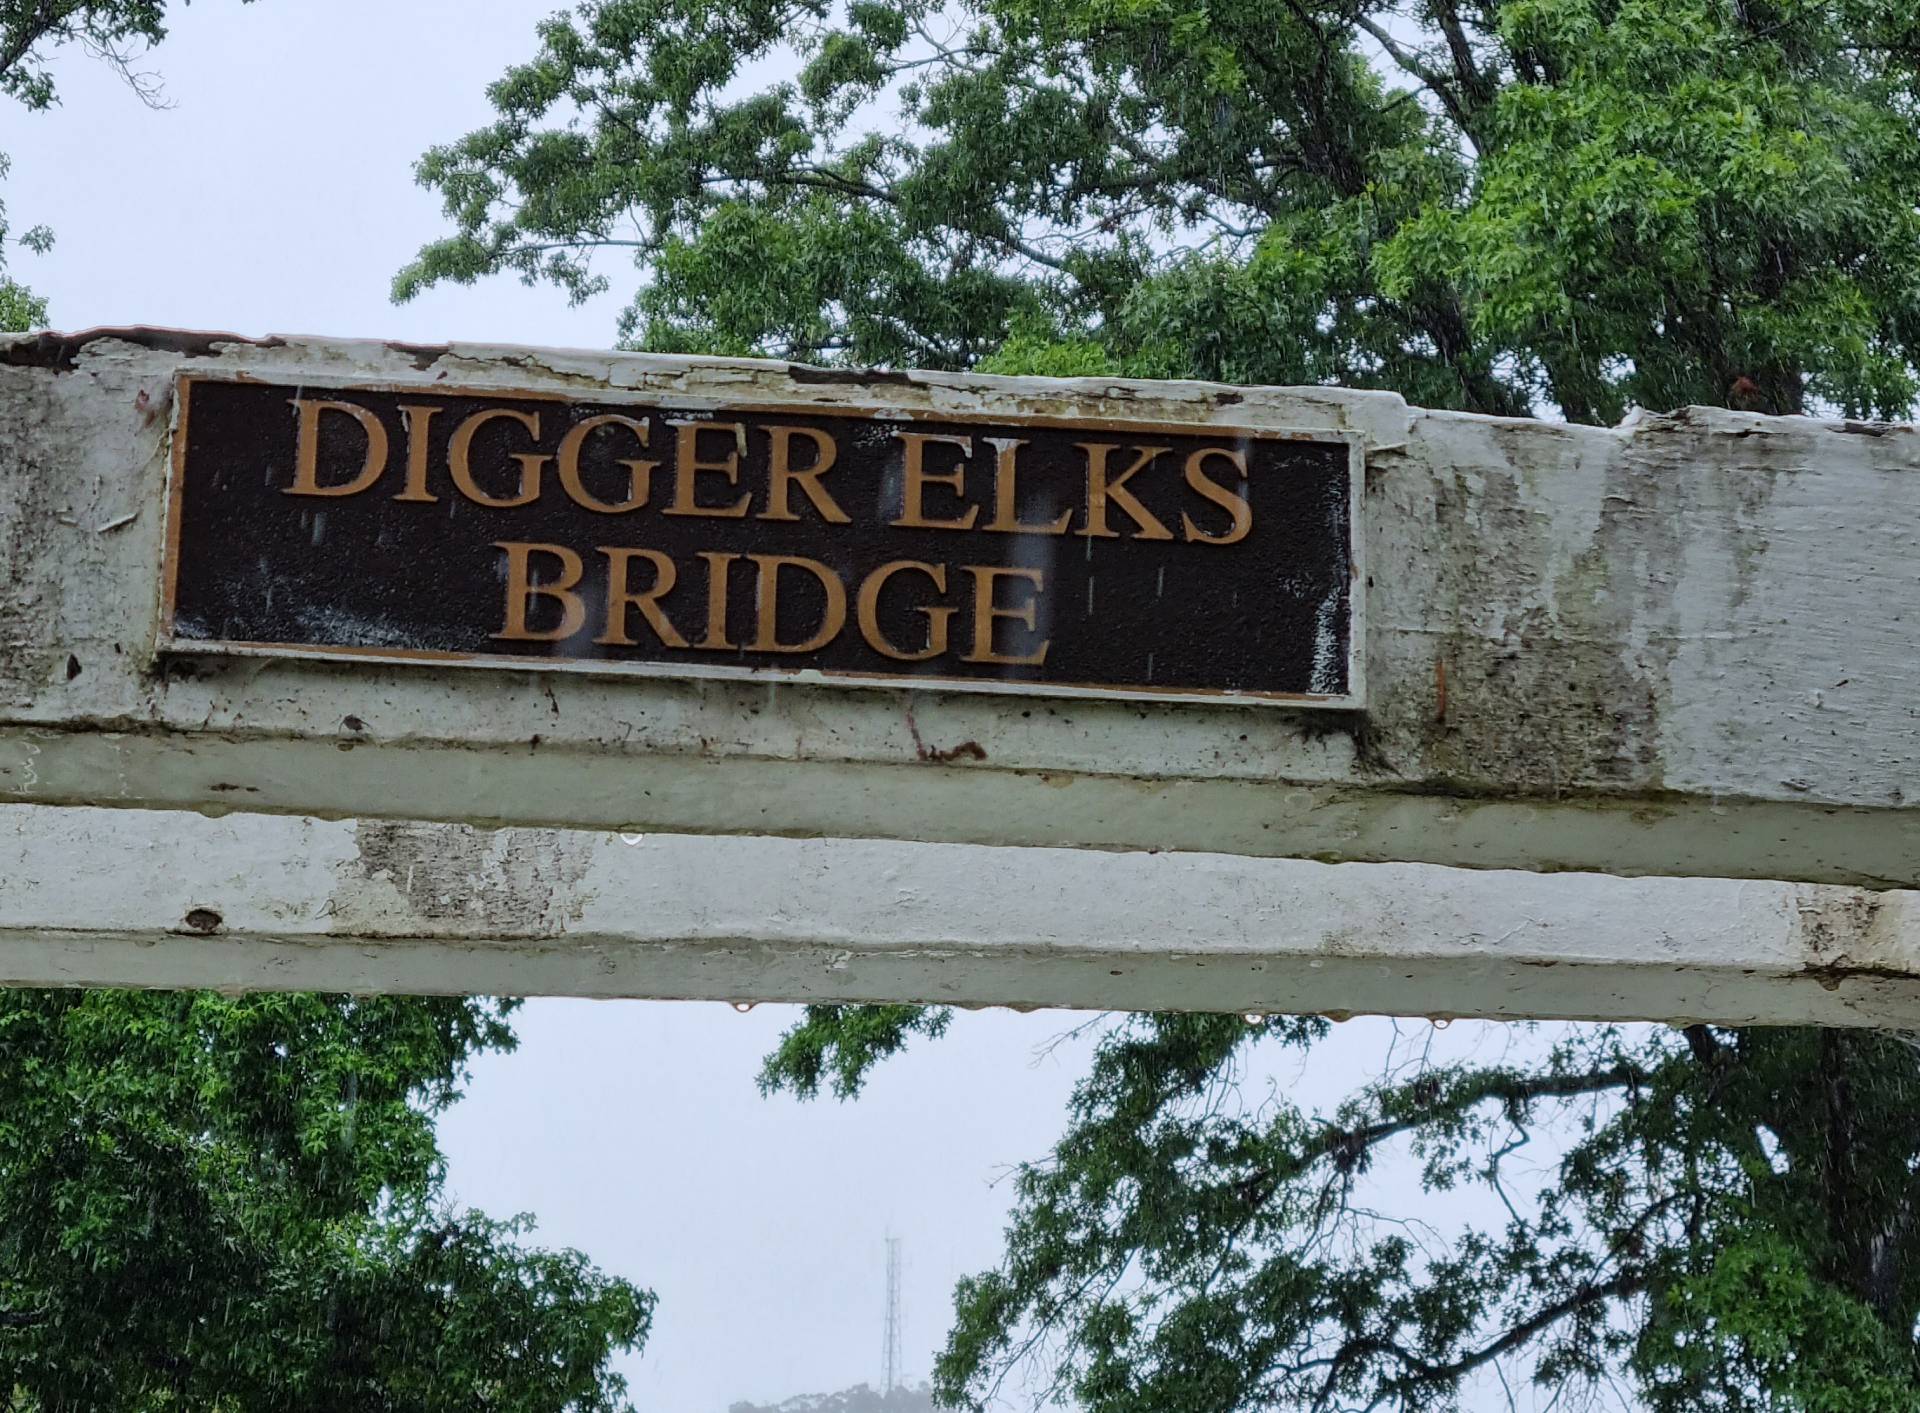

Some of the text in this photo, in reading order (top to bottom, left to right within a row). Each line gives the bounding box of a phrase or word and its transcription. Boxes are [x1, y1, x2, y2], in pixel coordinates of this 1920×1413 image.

[284, 397, 1254, 545] DIGGER ELKS
[490, 541, 1050, 666] BRIDGE
